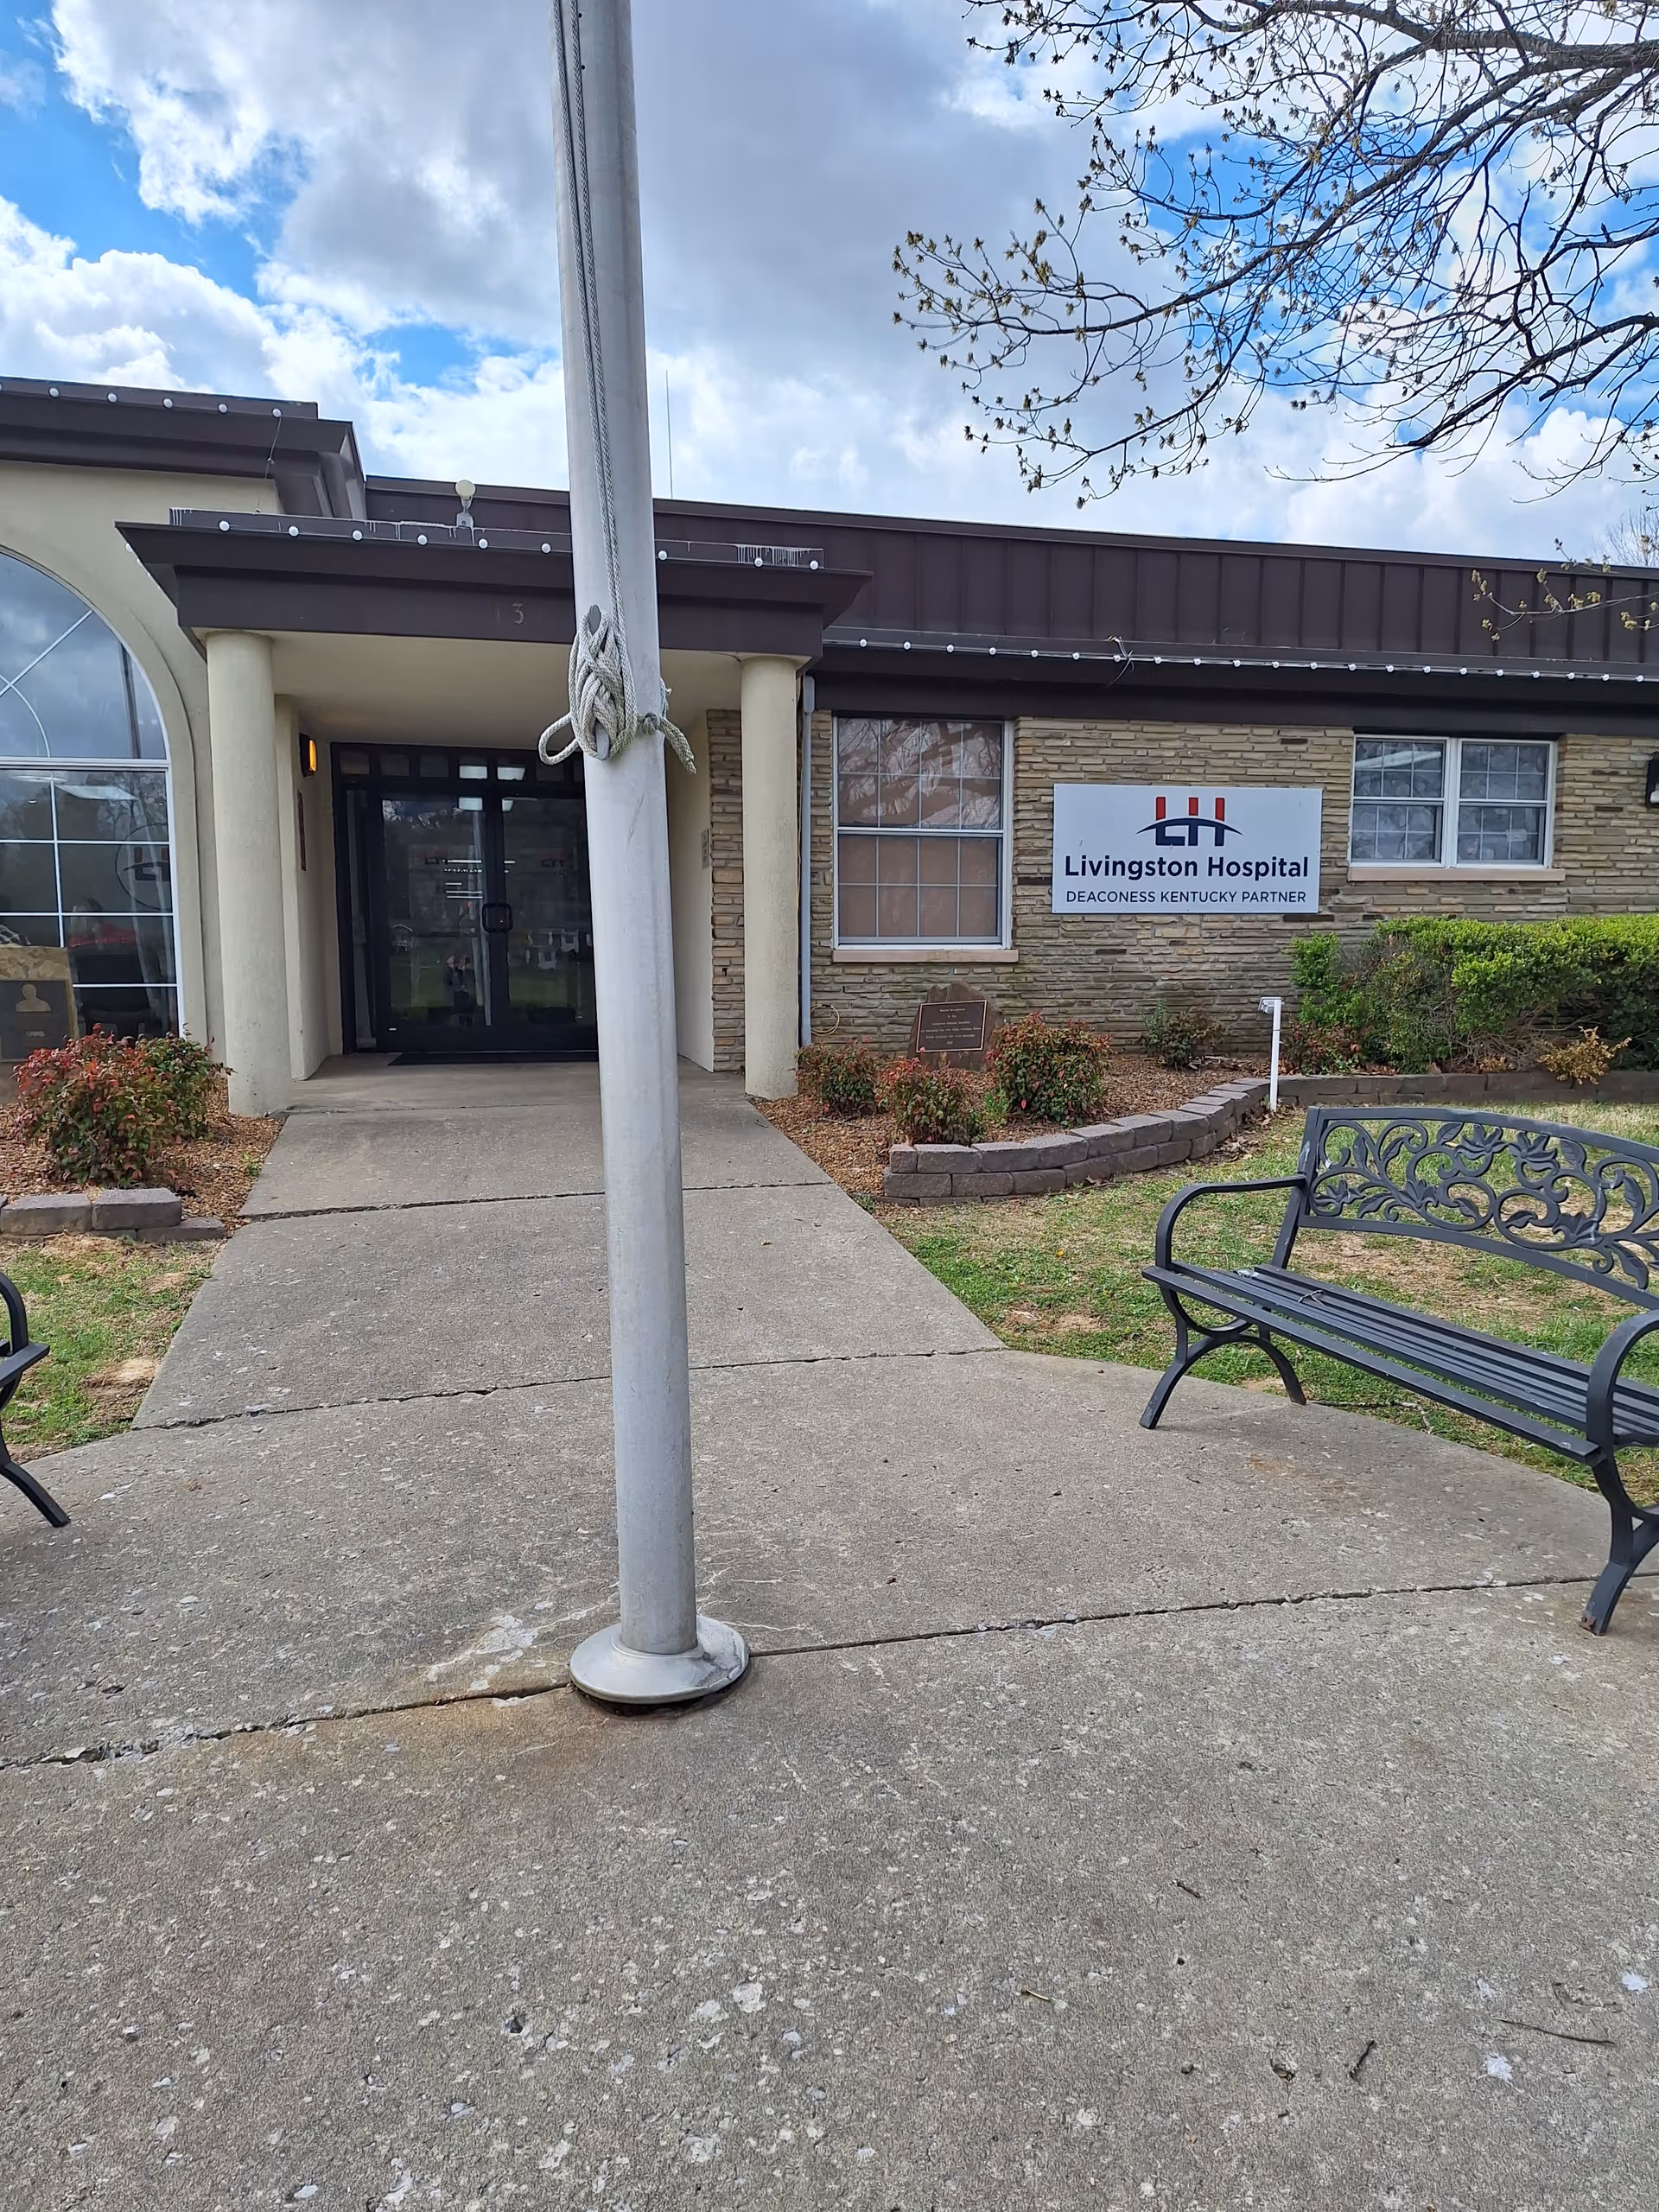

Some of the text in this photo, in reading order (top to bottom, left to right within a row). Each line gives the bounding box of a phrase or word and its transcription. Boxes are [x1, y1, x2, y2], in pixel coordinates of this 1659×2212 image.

[1065, 855, 1309, 881] Livingston Hospital
[1065, 891, 1306, 903] DEACONESS KENTUCKY PARTNER
